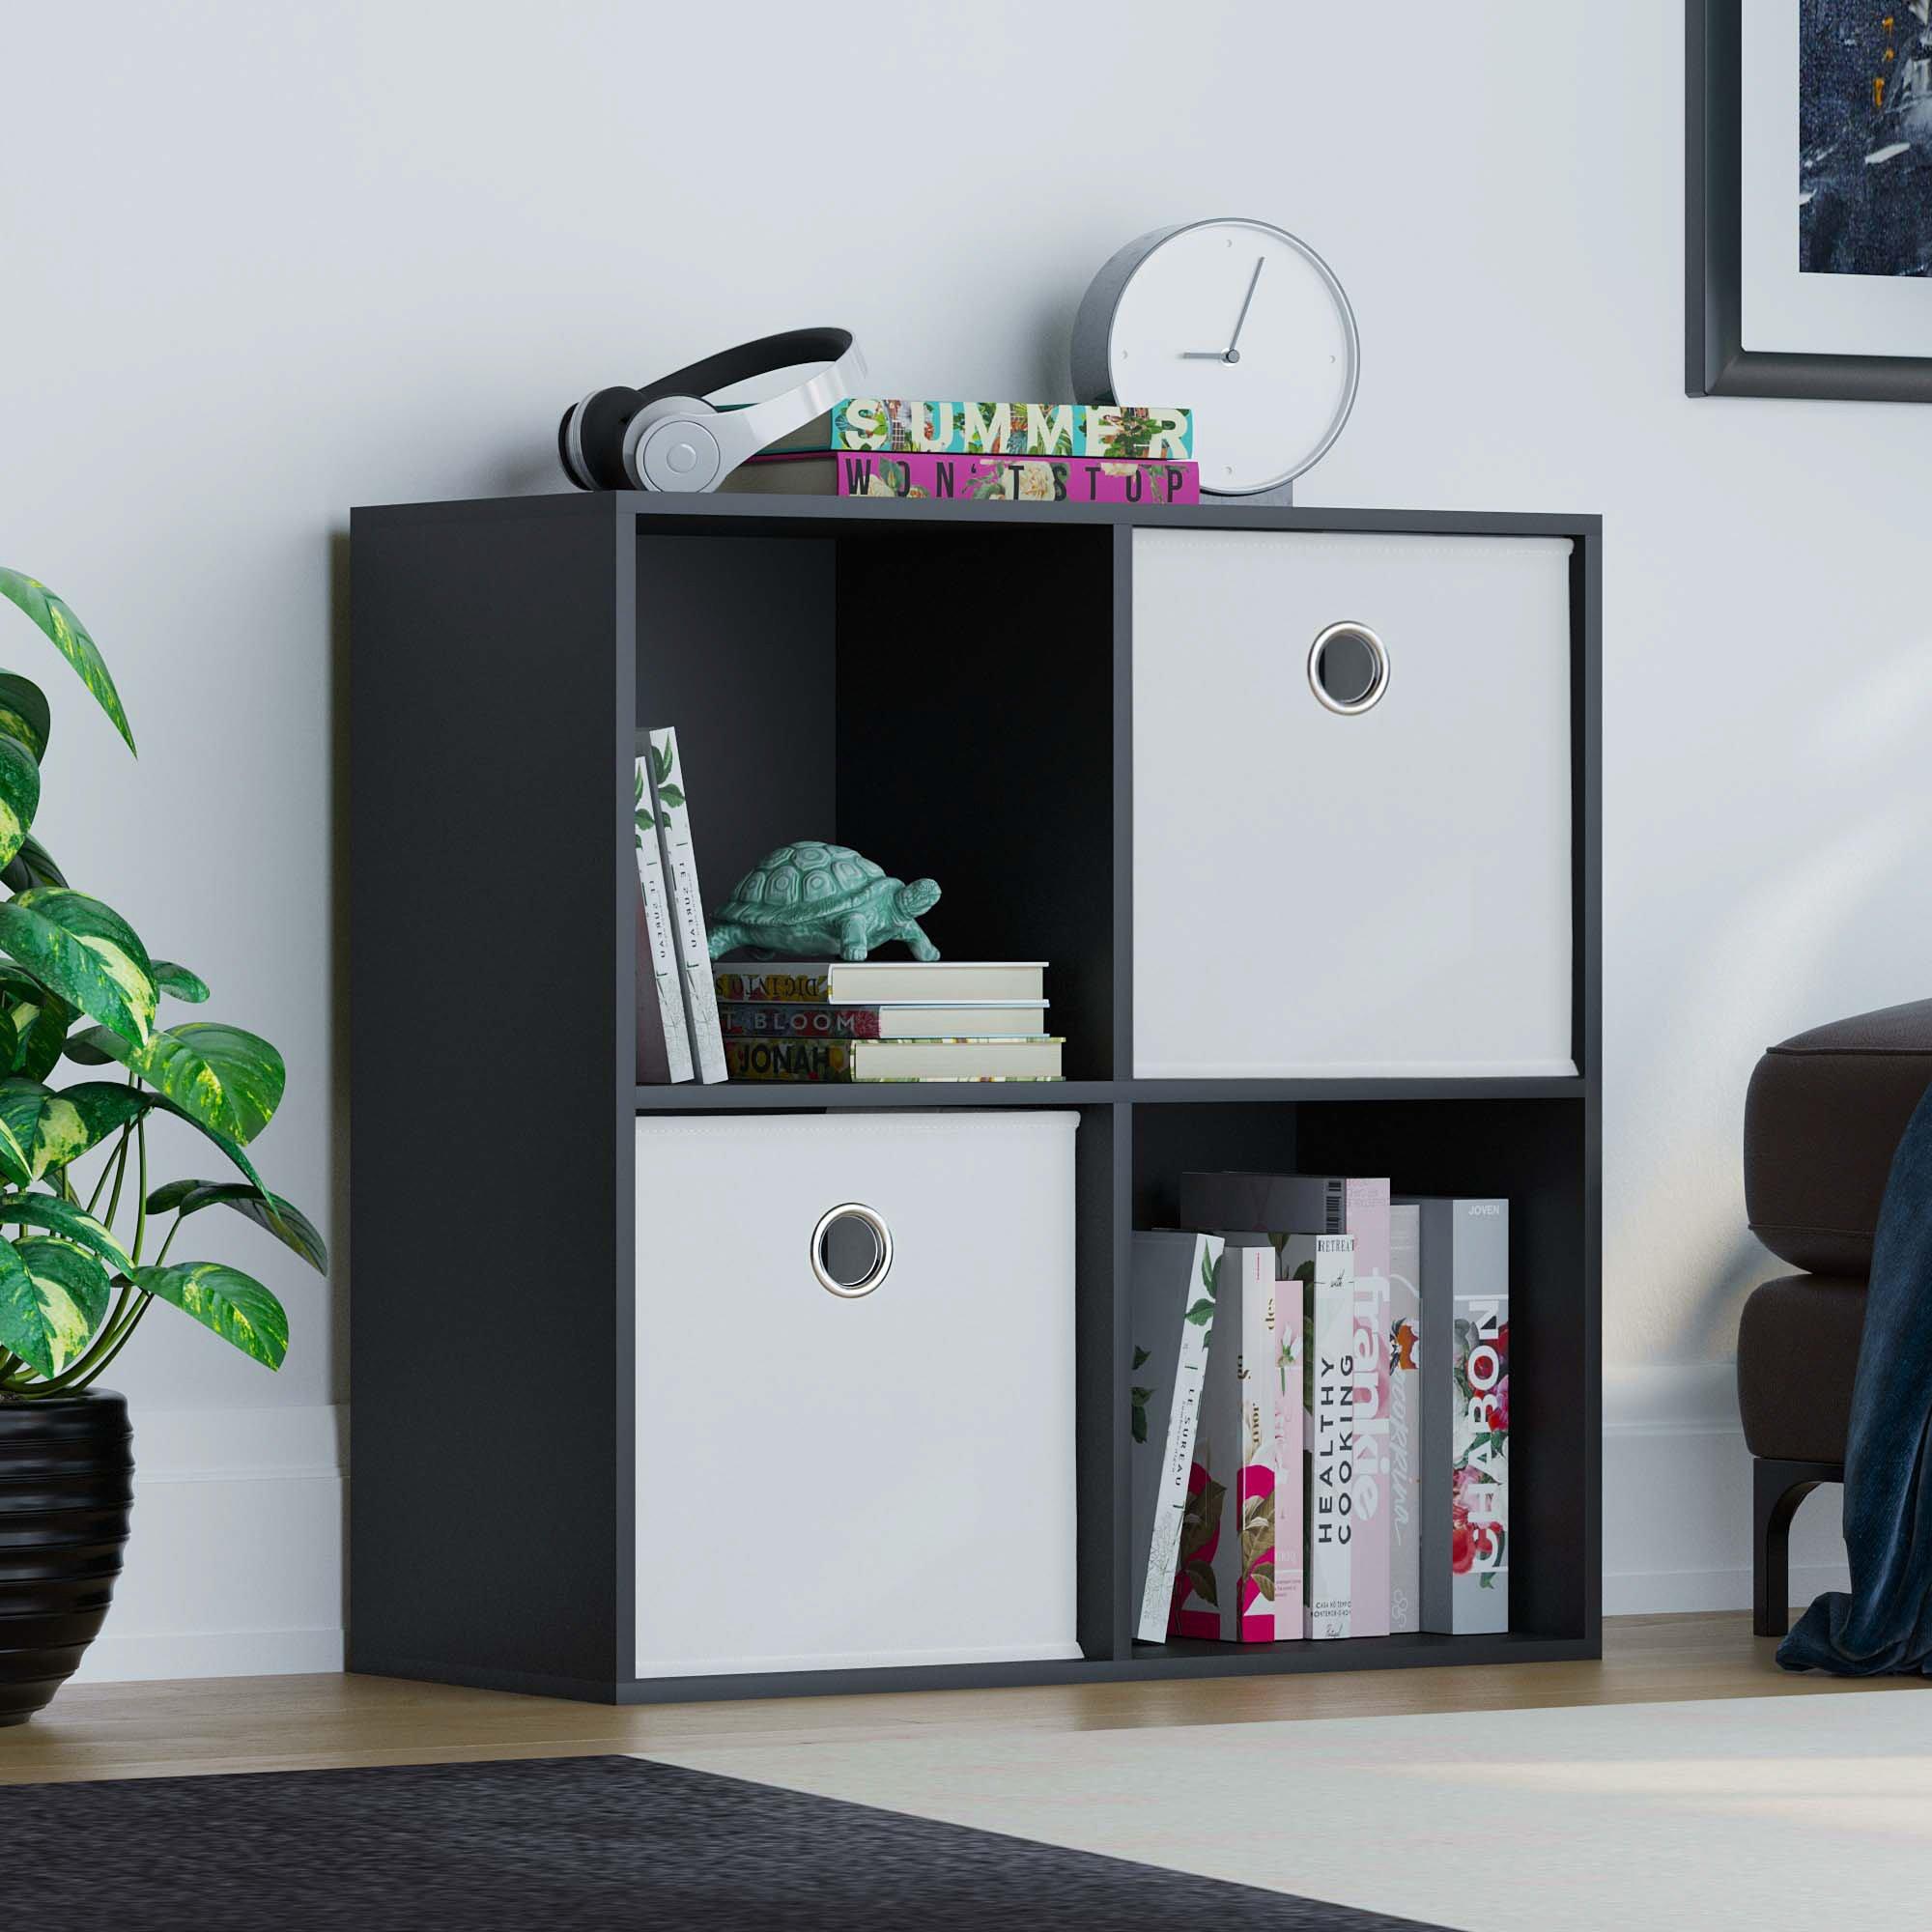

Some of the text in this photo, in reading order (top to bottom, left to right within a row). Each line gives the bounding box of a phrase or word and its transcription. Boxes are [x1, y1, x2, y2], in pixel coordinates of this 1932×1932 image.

[845, 398, 1193, 460] SUMMER
[1052, 464, 1183, 503] STOP
[739, 1041, 833, 1074] JONAH
[754, 1012, 856, 1031] BLOOM
[1318, 1357, 1334, 1544] HEALTHY
[1338, 1354, 1353, 1545] COOKING
[1352, 1268, 1391, 1521] frankie
[1467, 1300, 1499, 1567] CHABON
